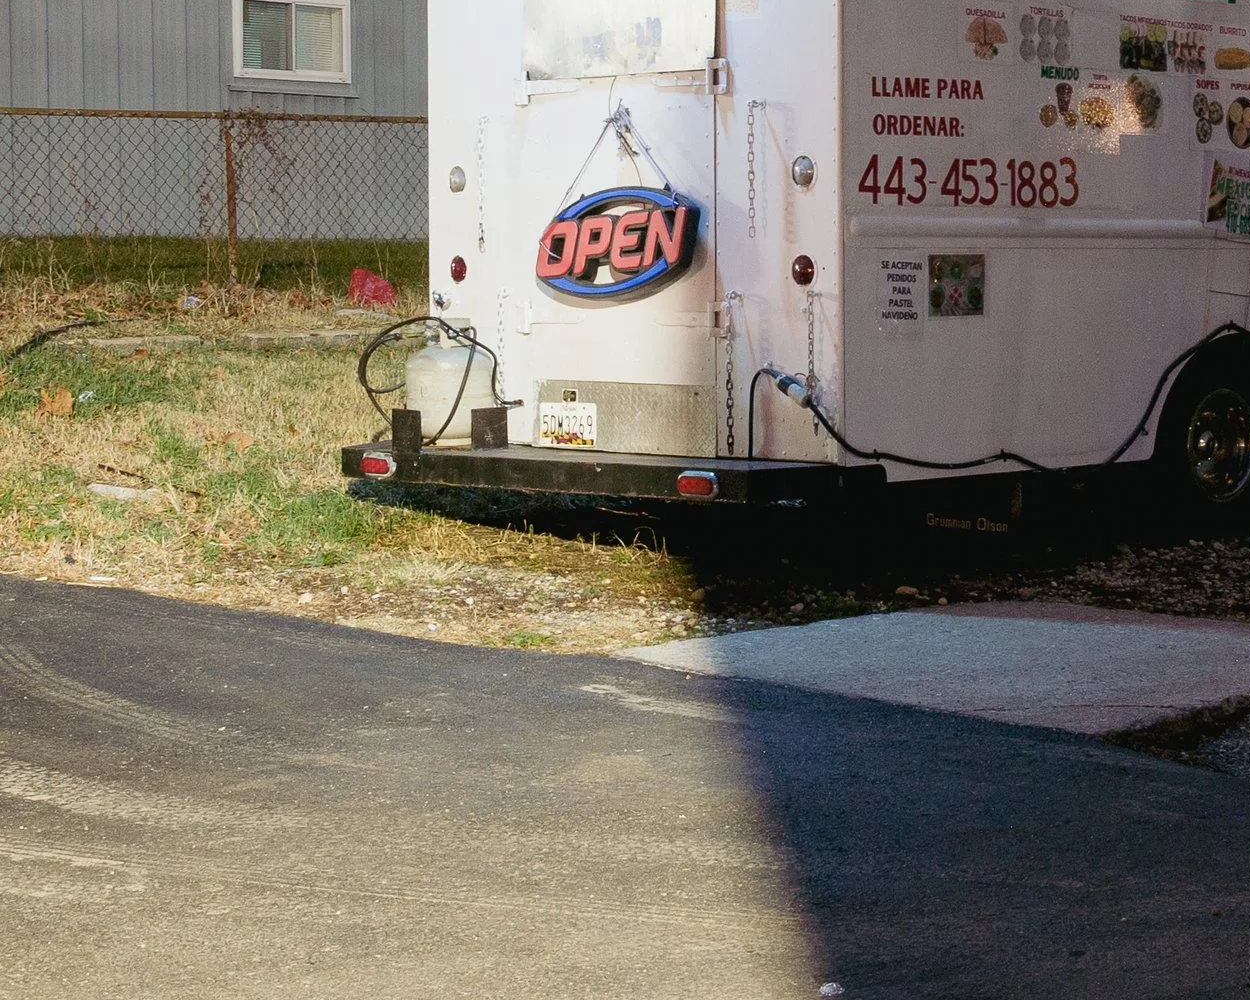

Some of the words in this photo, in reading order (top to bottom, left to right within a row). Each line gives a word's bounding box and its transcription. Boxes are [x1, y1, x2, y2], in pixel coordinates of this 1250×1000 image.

[965, 7, 1007, 20] QUESADILLA
[1029, 6, 1065, 19] TORTILLAS
[1119, 14, 1137, 24] TACOS
[1167, 20, 1186, 30] TACOS
[1186, 22, 1213, 33] DORADOS
[1219, 25, 1248, 37] BURRITO
[1040, 65, 1080, 83] MENUDO
[871, 76, 931, 100] LLAME
[936, 79, 984, 102] PARA
[1195, 79, 1220, 92] SOPES
[872, 113, 966, 139] ORDENAR:
[858, 153, 1081, 209] 443-453-1883
[536, 206, 688, 279] OPEN
[881, 260, 890, 270] SE
[891, 260, 923, 271] ACEPTAN
[886, 273, 917, 284] PEDIDOS
[892, 286, 912, 296] PARA
[888, 298, 914, 309] PASTEL
[881, 308, 919, 321] NAVIDEÑO
[925, 512, 972, 530] Grumman
[976, 516, 1009, 533] Olson
